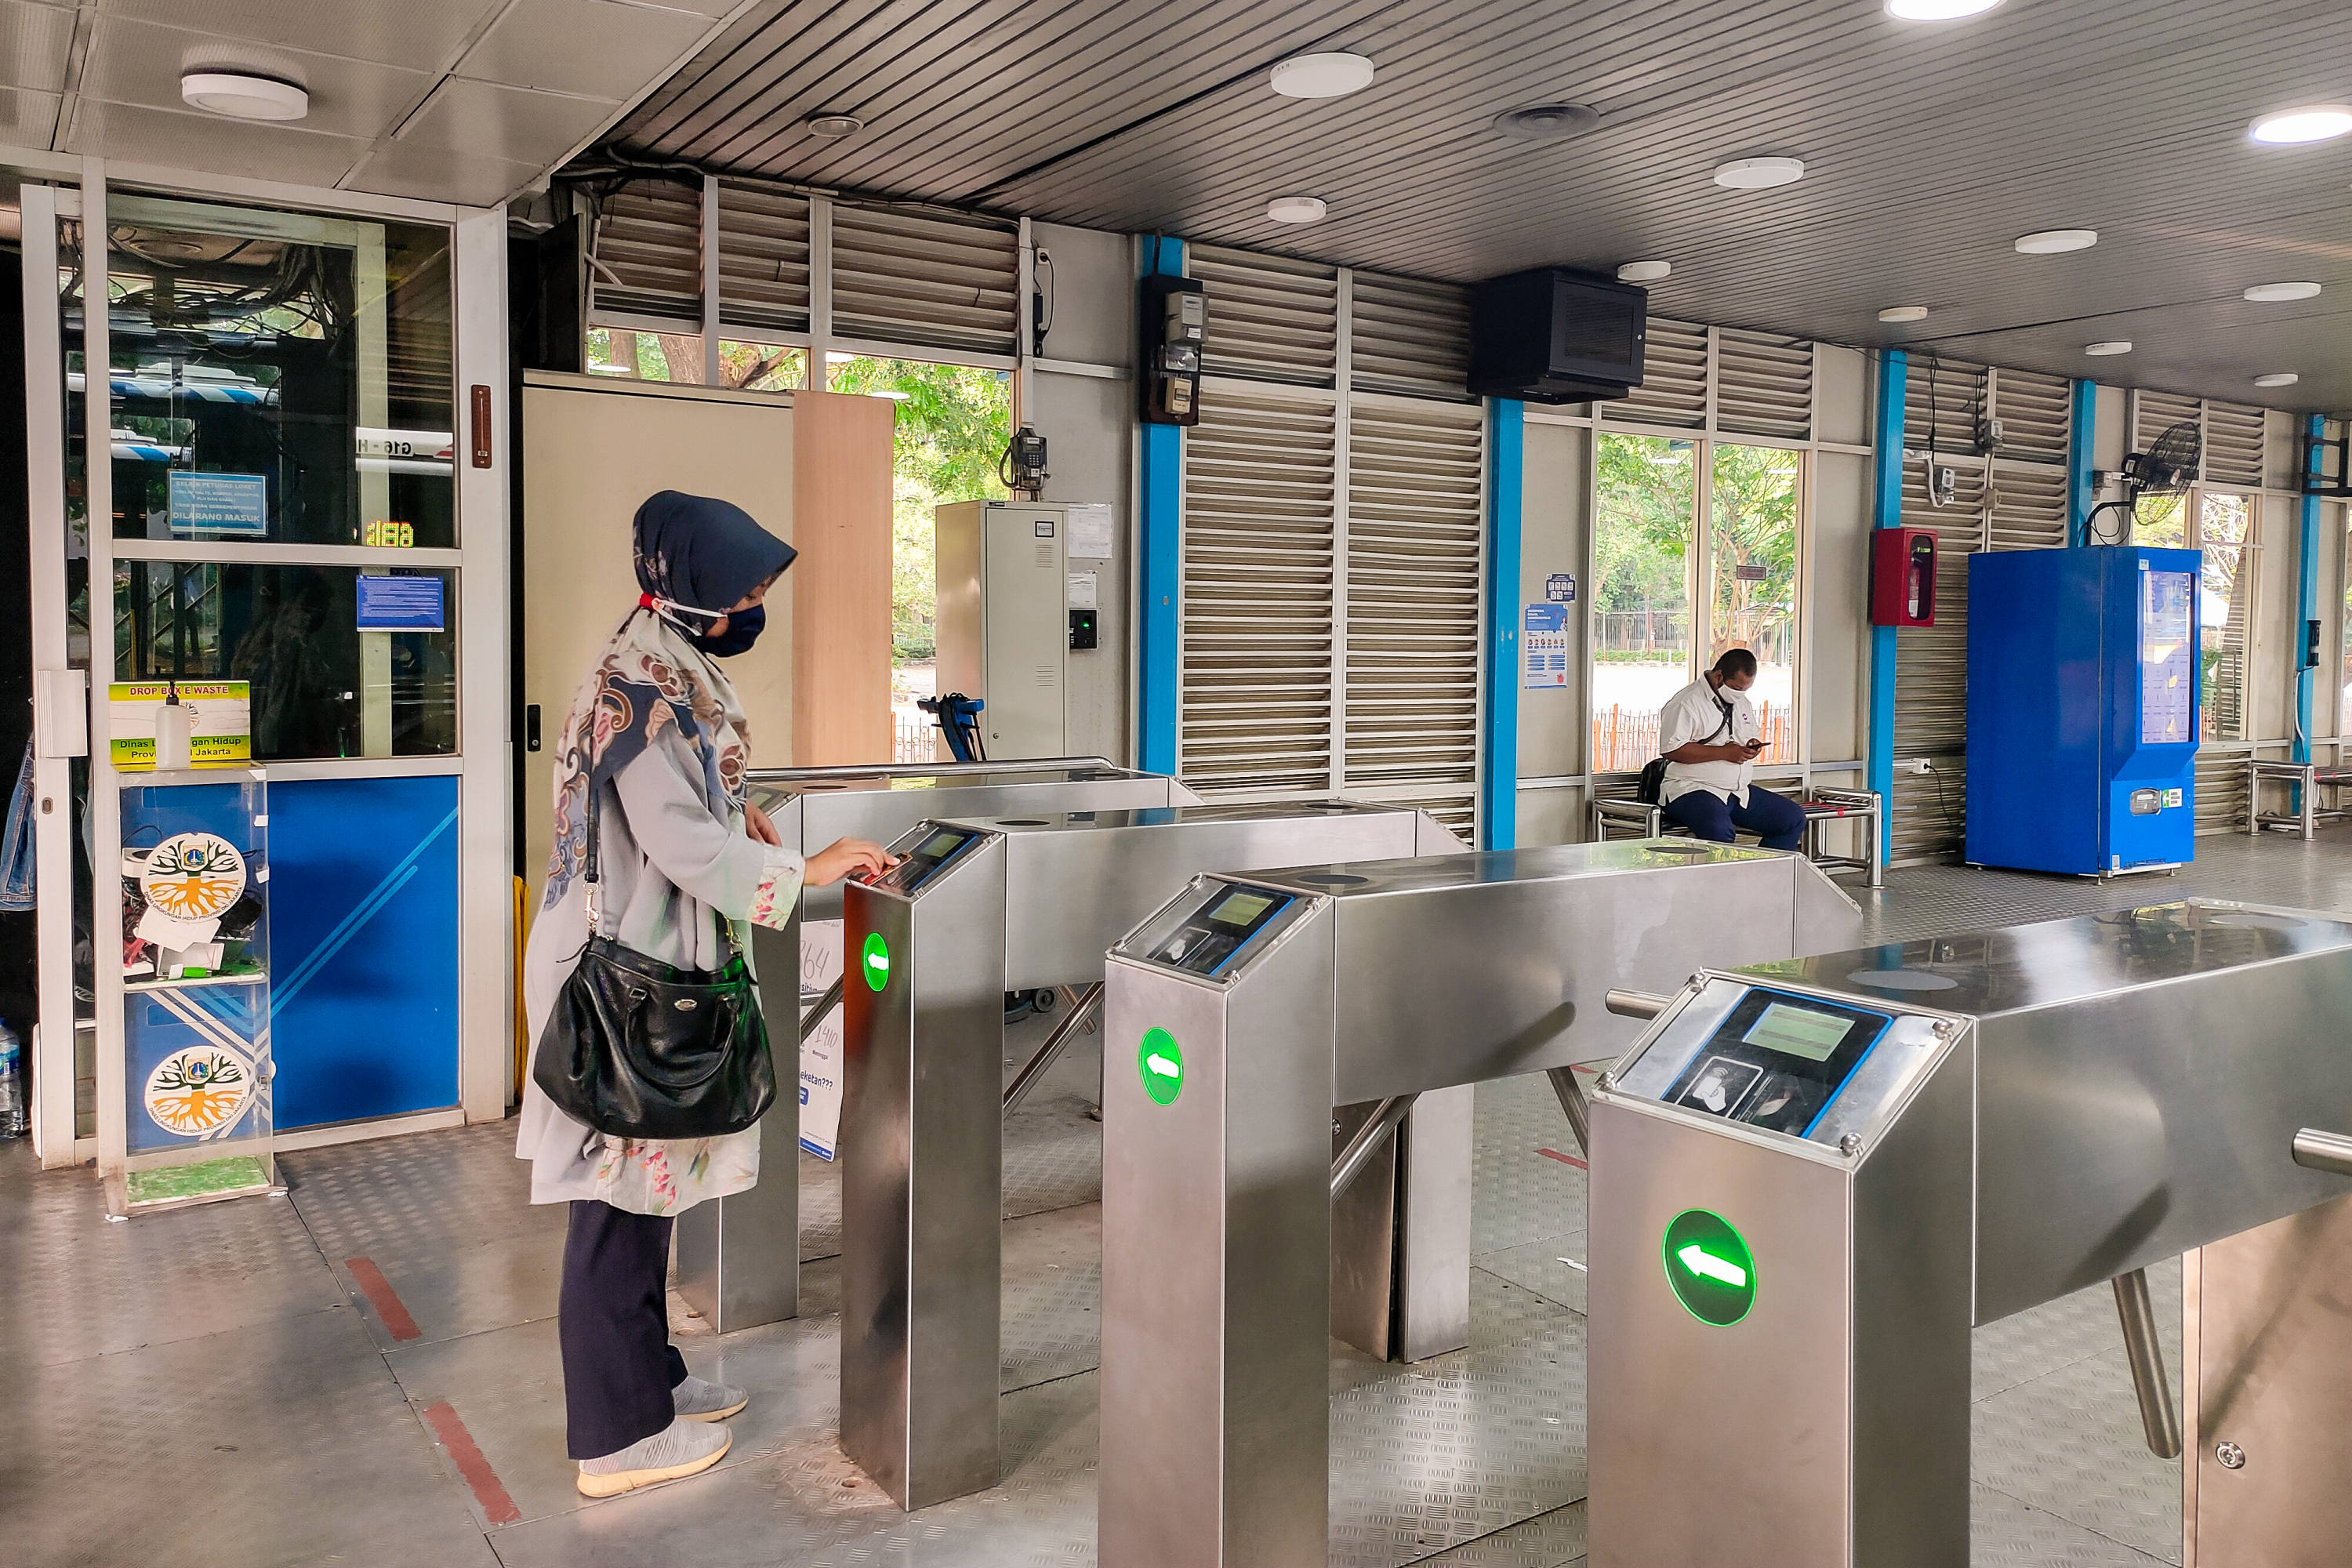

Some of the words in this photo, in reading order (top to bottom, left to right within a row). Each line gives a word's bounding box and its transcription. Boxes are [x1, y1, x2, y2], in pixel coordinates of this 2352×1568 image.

[172, 511, 223, 521] DILARANG
[225, 514, 260, 522] MASUK
[130, 687, 157, 695] DROP
[212, 737, 241, 746] Hidup
[229, 887, 243, 906] JAKARTA
[800, 1070, 833, 1091] eketan???
